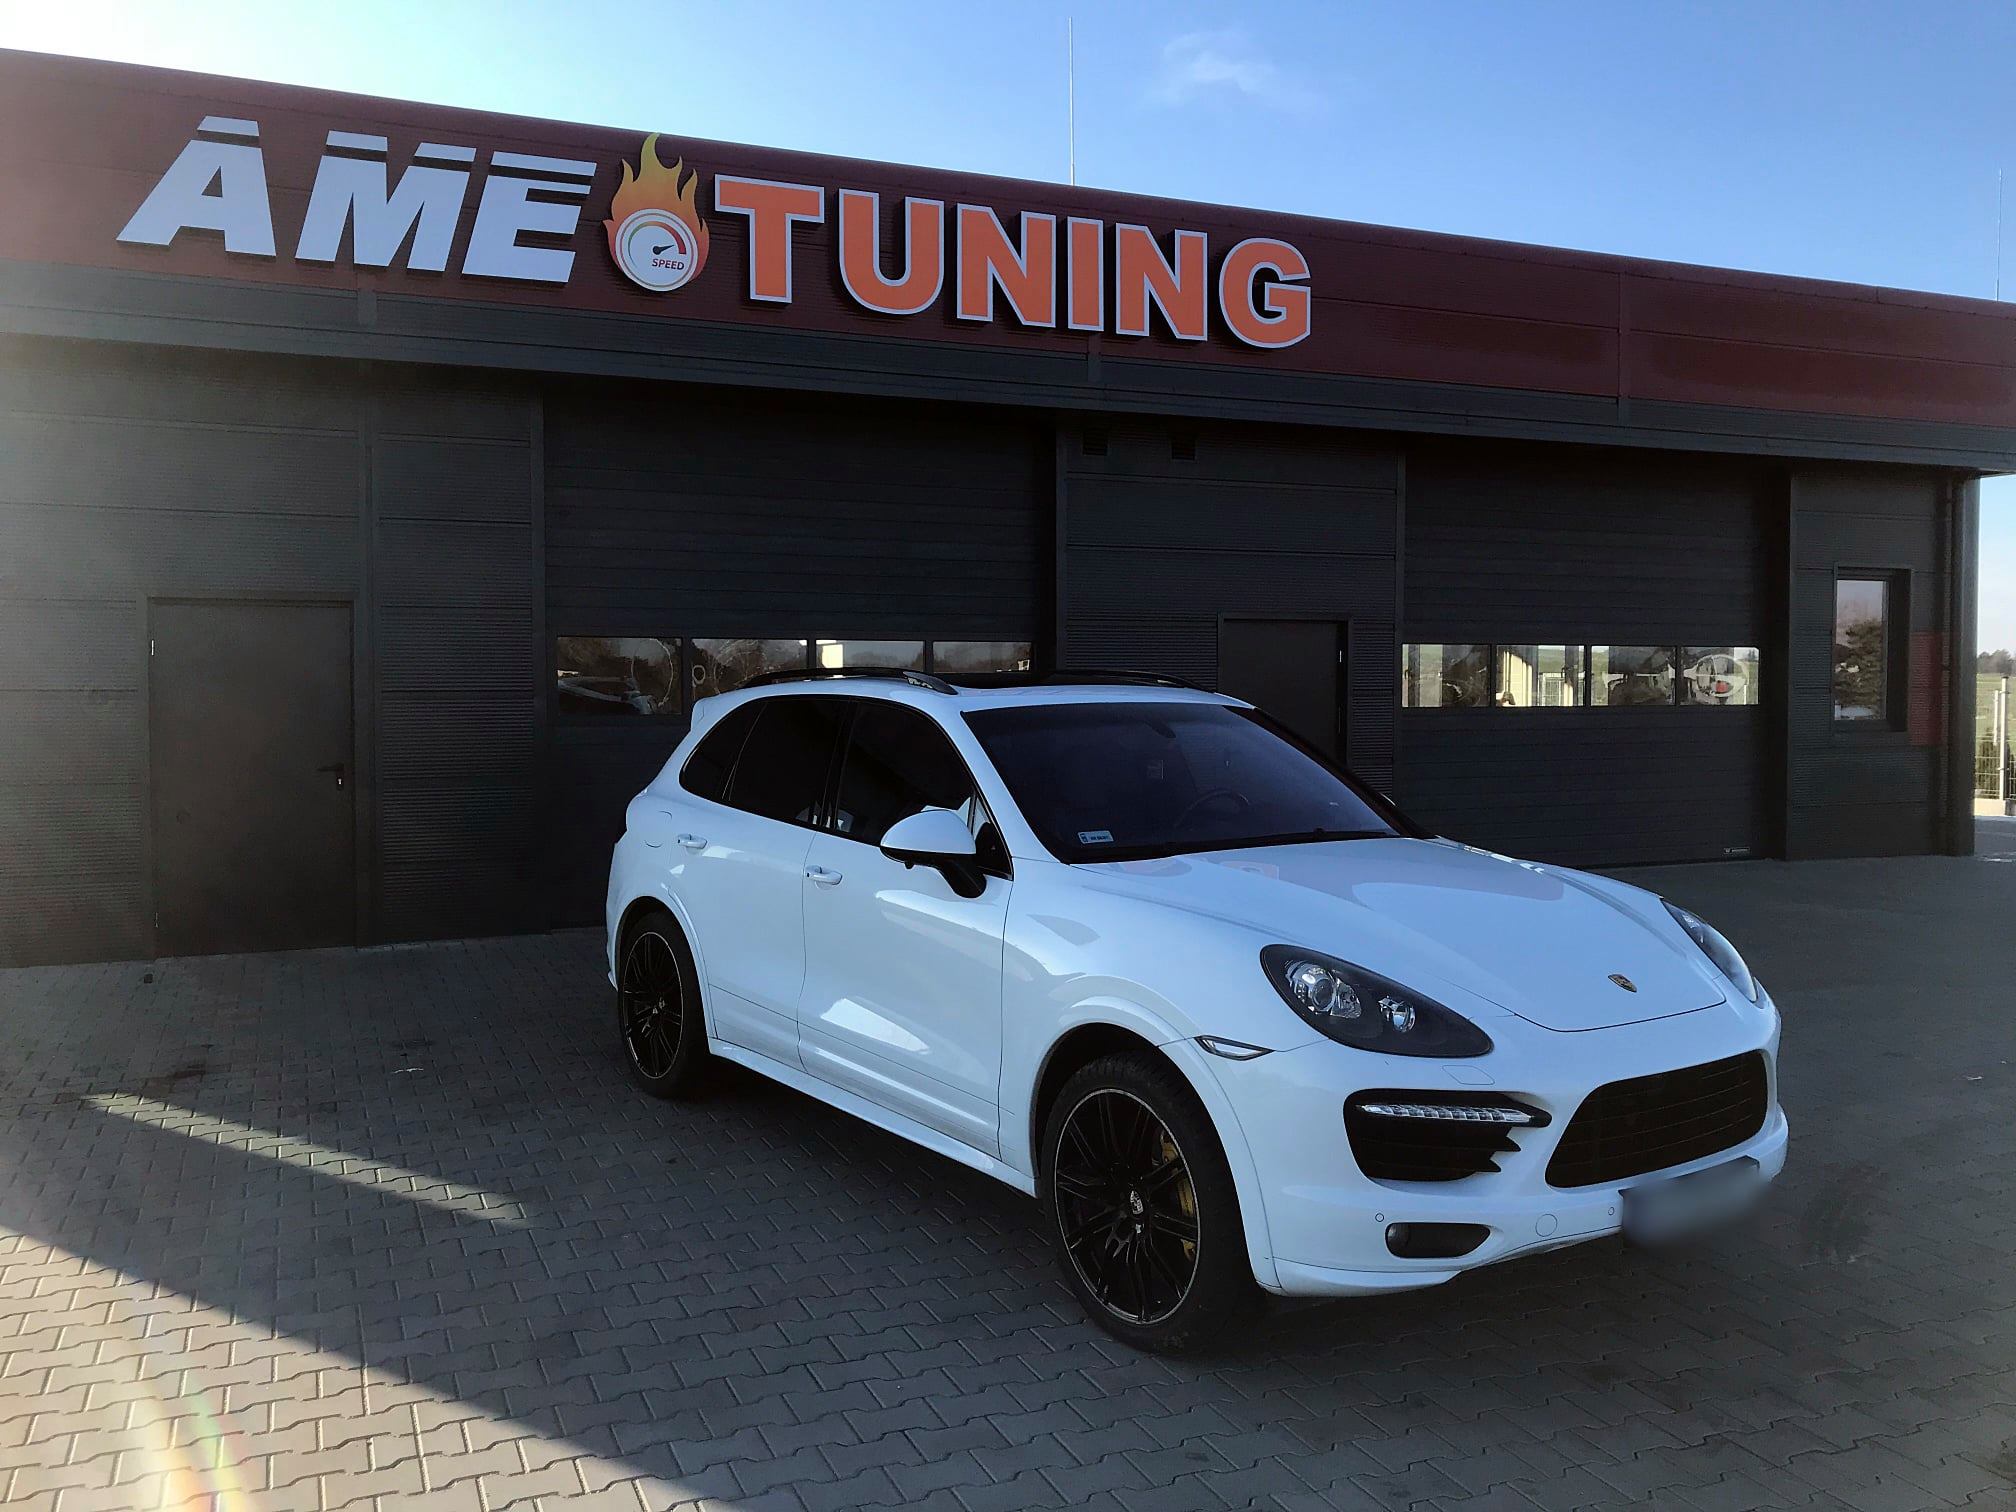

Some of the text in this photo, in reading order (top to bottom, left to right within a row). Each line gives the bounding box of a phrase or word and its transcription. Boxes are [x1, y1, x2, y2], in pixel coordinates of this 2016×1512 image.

[116, 115, 1312, 349] AME TUNING
[652, 258, 685, 270] SPEED
